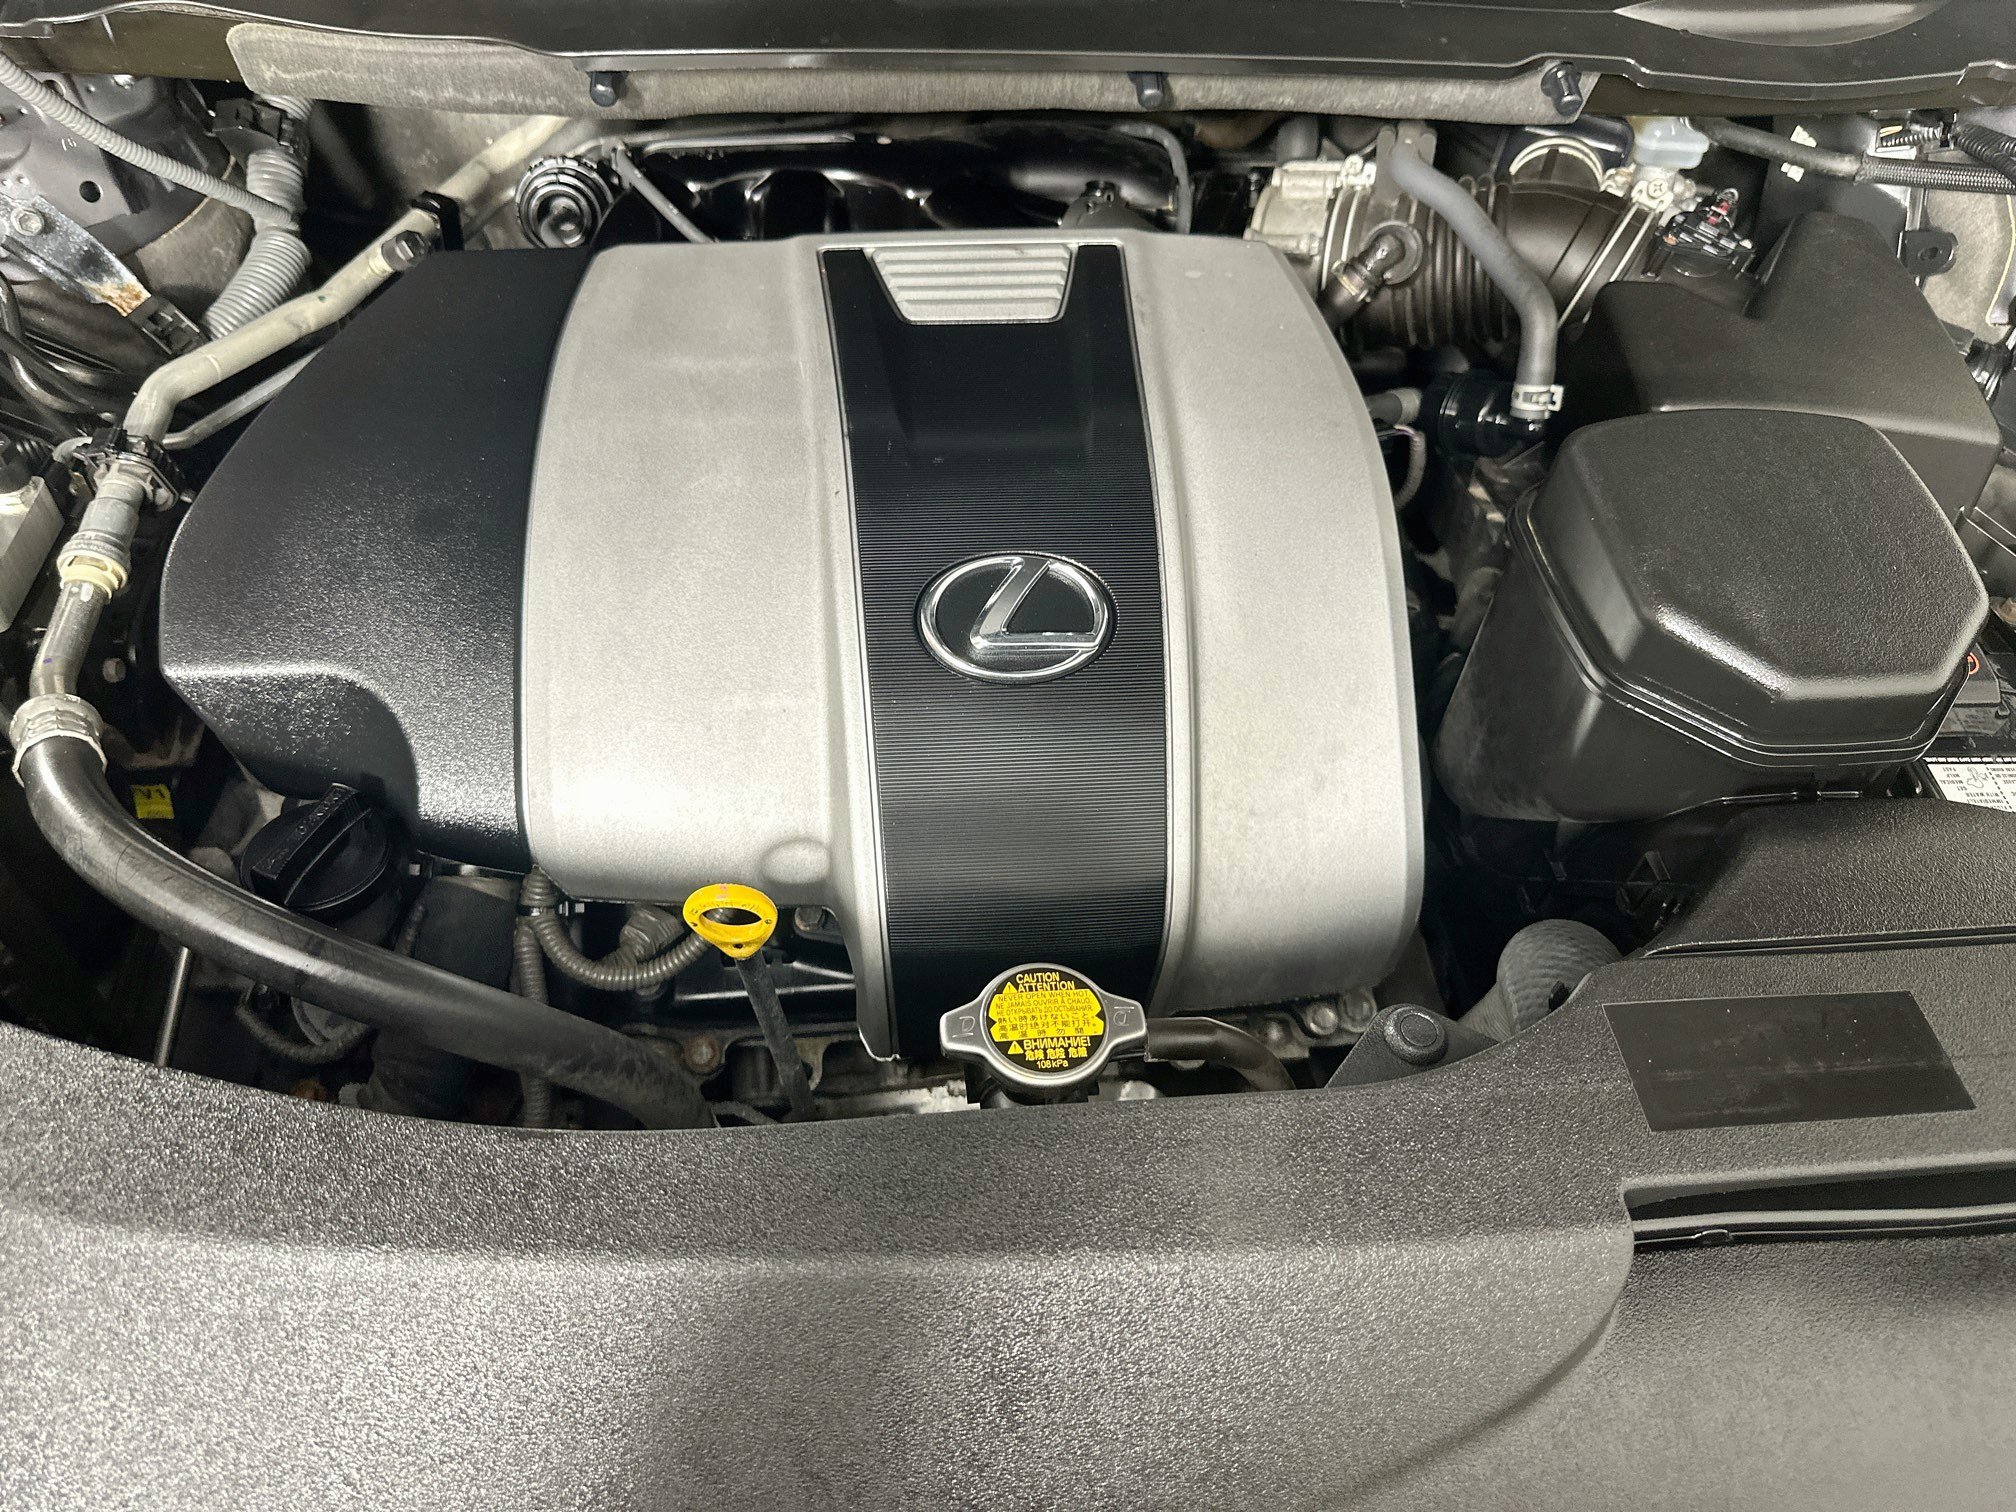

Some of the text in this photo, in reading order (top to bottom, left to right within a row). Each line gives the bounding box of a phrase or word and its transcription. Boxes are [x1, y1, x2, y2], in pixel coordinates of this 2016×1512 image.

[1016, 971, 1060, 984] CAUTION
[1017, 980, 1076, 993] ATTENTION
[998, 990, 1091, 1002] NEVER OPEN WHEN HOT.
[996, 1002, 1005, 1010] NE
[1007, 1000, 1032, 1009] JAMAIS
[1033, 999, 1059, 1007] OUVRIR
[1023, 1036, 1092, 1050] ВНИМАНИЕ!
